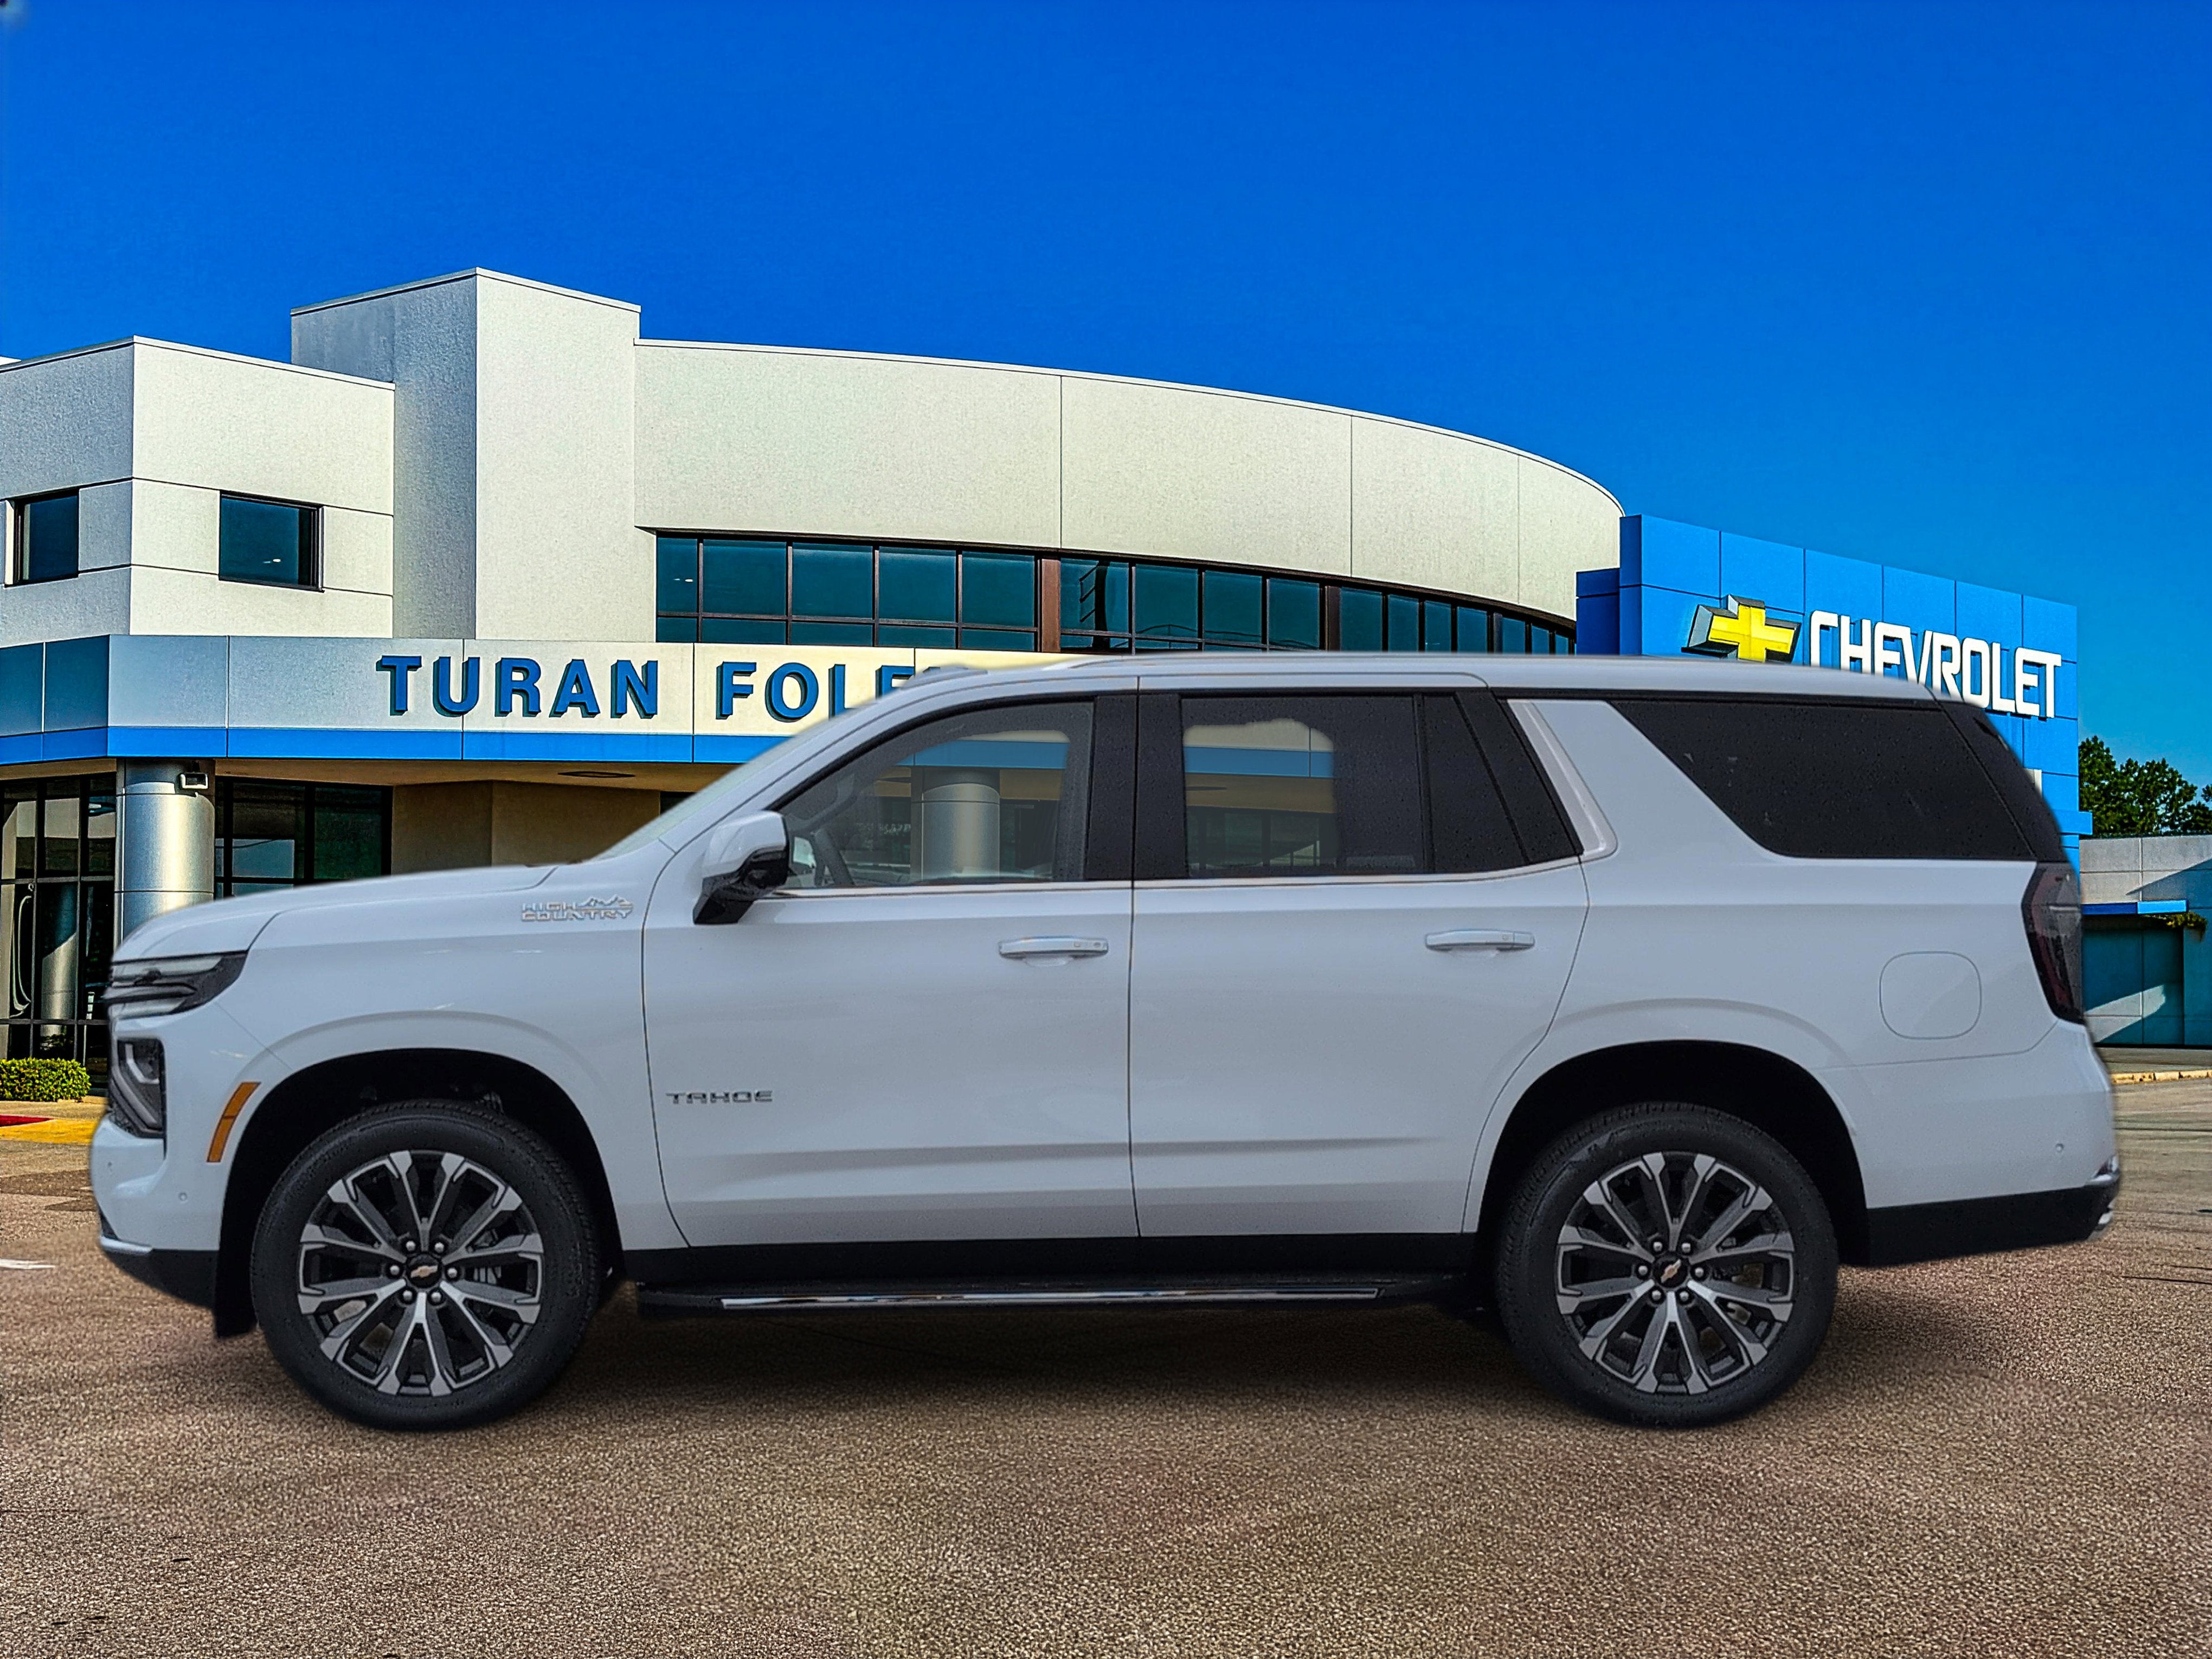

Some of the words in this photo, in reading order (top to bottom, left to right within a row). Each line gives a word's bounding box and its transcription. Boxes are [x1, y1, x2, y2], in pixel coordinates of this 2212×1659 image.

[1810, 610, 2062, 718] CHEVROLET
[376, 655, 658, 719] TURAN
[522, 902, 577, 911] HIGH
[522, 909, 633, 922] COUNTRY
[665, 1090, 773, 1104] TAHOE
